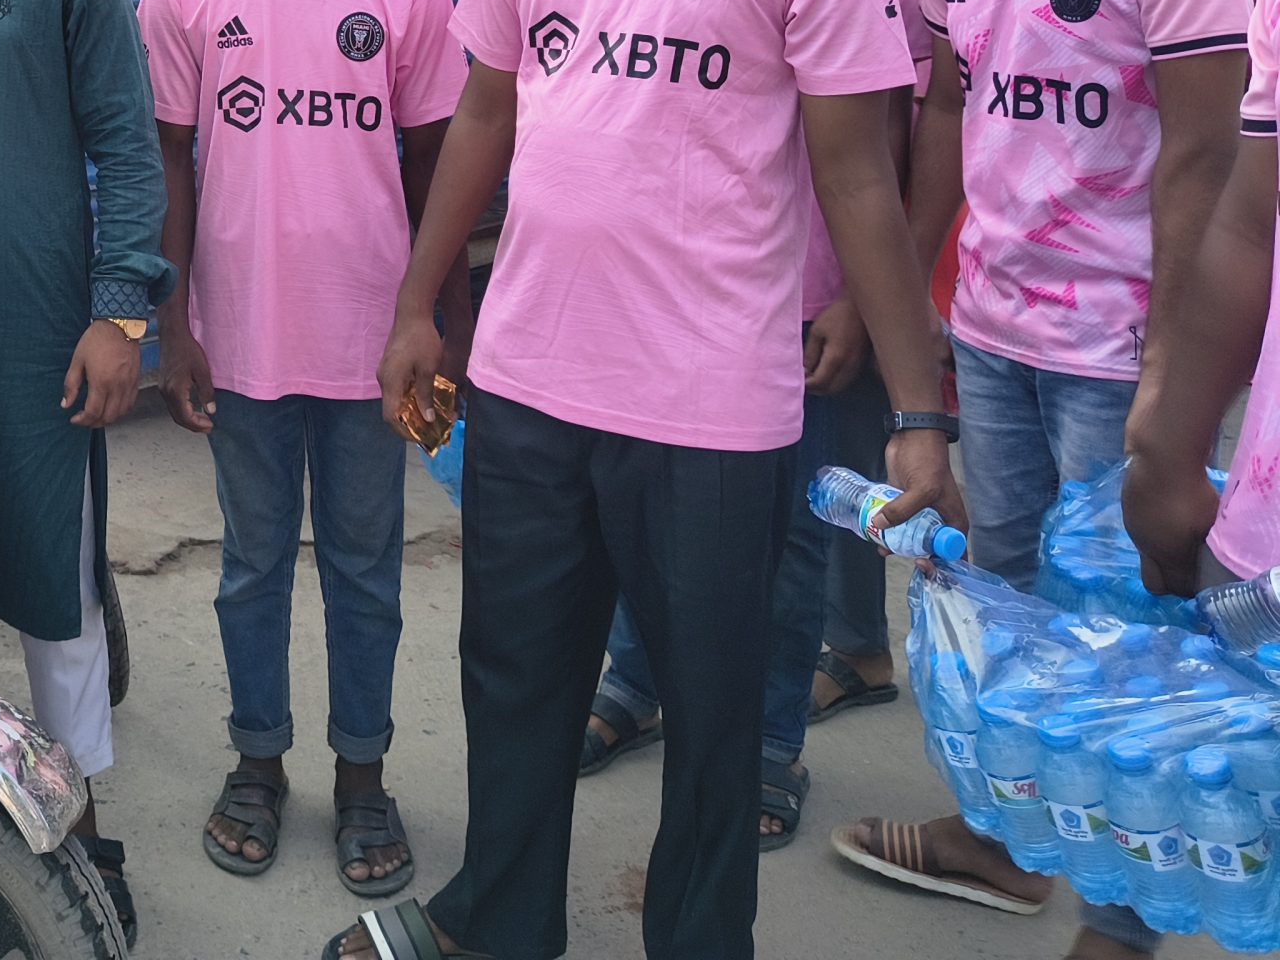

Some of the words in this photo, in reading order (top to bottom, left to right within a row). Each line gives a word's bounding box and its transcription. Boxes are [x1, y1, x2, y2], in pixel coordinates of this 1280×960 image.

[217, 35, 253, 49] adidas
[591, 31, 731, 90] XBTO
[276, 88, 382, 132] XBTO
[987, 71, 1110, 129] XBTO
